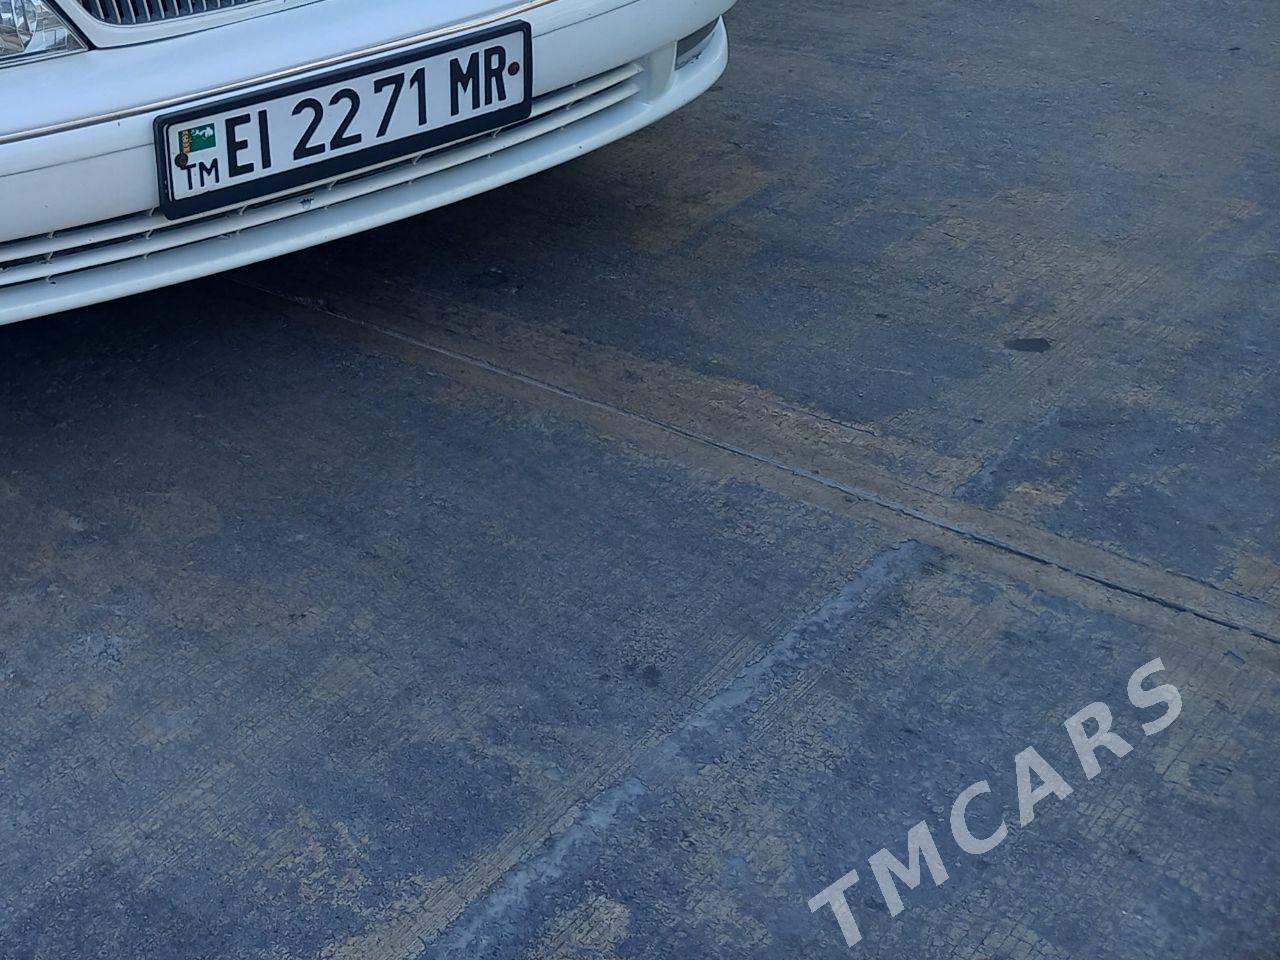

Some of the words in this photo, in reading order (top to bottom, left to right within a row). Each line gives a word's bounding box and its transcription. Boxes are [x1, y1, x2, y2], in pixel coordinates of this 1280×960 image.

[225, 109, 272, 178] EI
[291, 67, 428, 162] 2271
[449, 45, 507, 117] MR
[183, 157, 220, 191] TM
